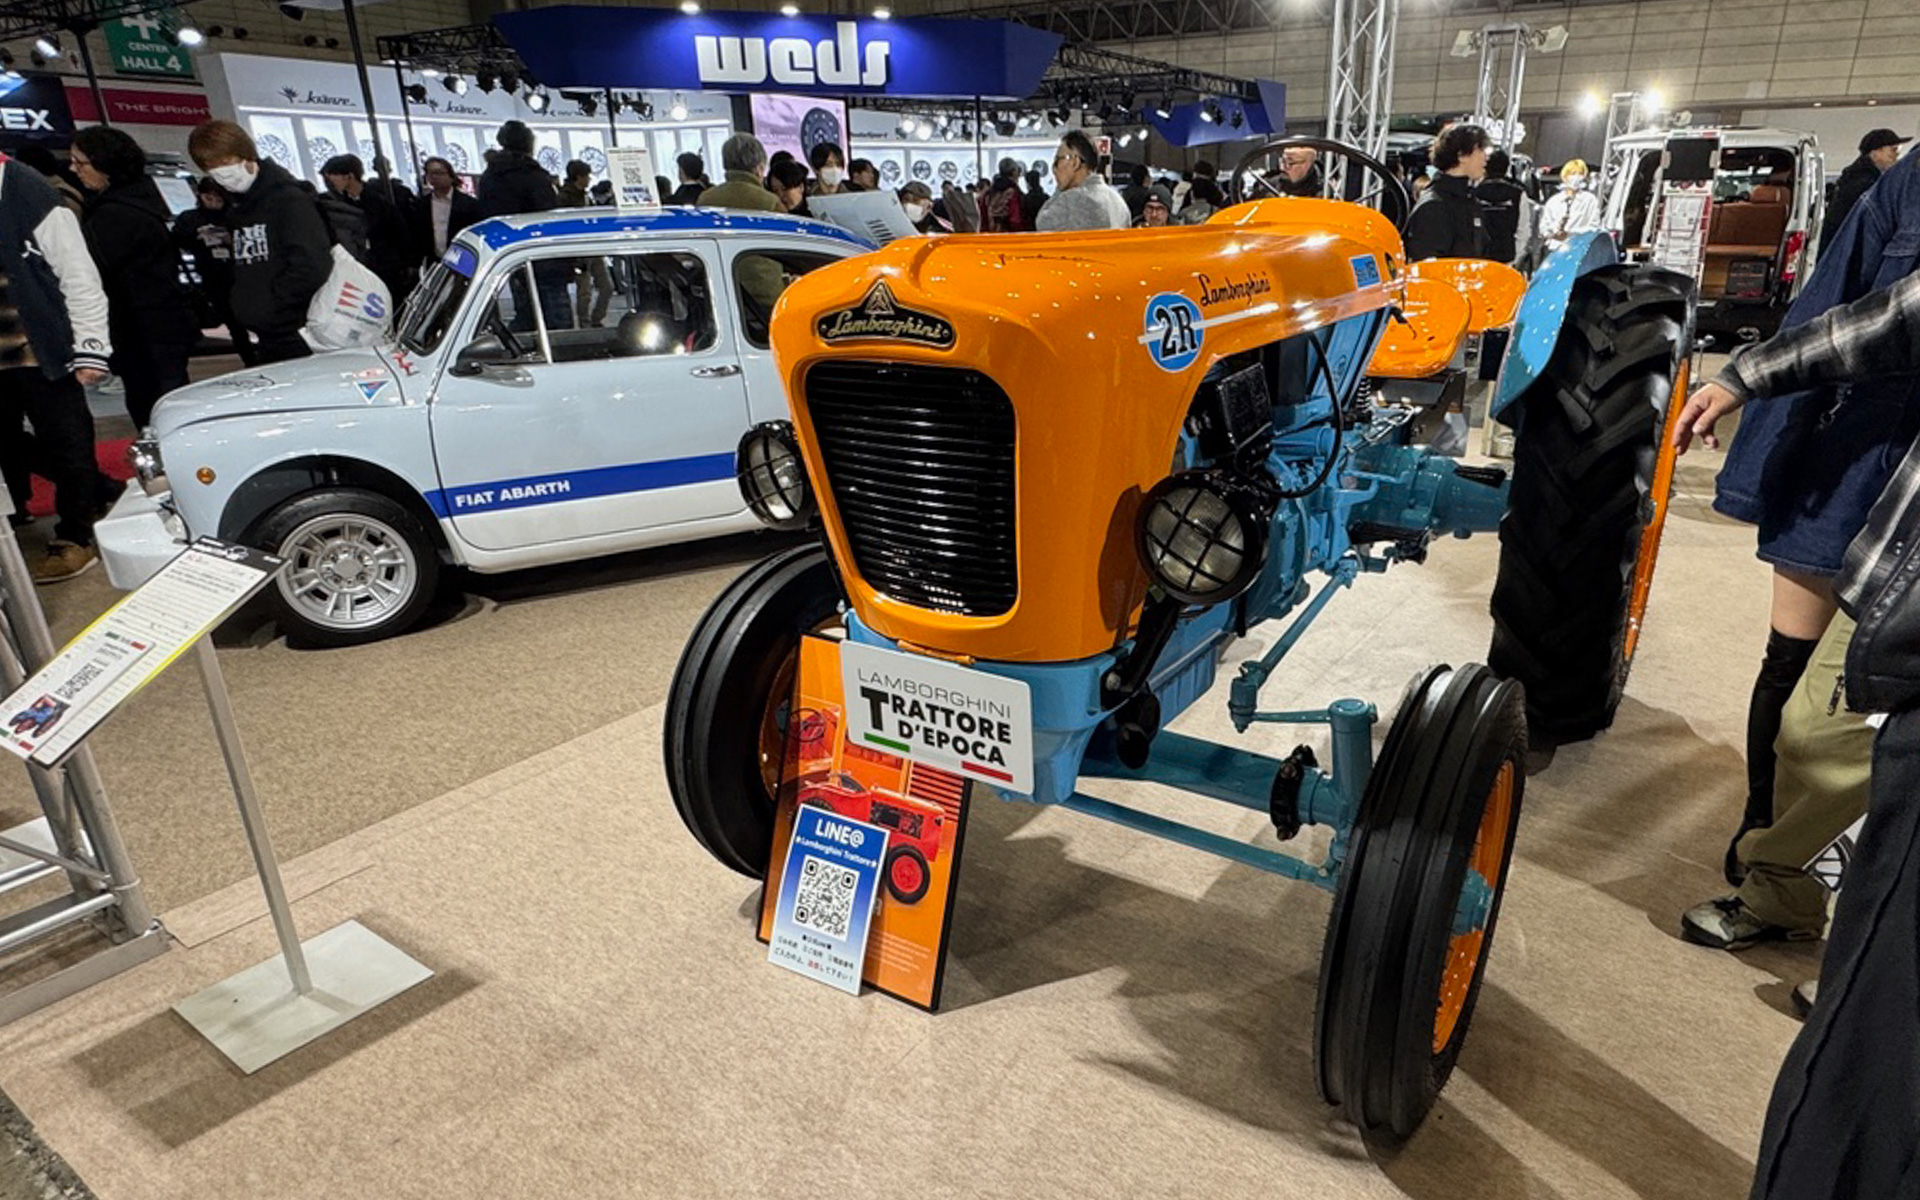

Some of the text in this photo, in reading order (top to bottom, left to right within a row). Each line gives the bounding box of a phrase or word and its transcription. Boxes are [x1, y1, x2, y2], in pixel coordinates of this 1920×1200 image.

[128, 42, 169, 53] CENTER
[695, 21, 890, 86] weds
[121, 55, 182, 72] HALL 4
[0, 107, 55, 132] EX
[114, 102, 150, 113] THE
[1199, 271, 1271, 307] Lamborghini
[827, 310, 942, 337] Lamborghini
[1154, 304, 1198, 359] 2R
[455, 479, 571, 508] FIAT ABARTH
[858, 668, 1011, 719] LAMBORGHINI
[860, 686, 1012, 744] TRATTORE
[898, 720, 1006, 767] D'EPOCA
[815, 819, 864, 848] LINE@
